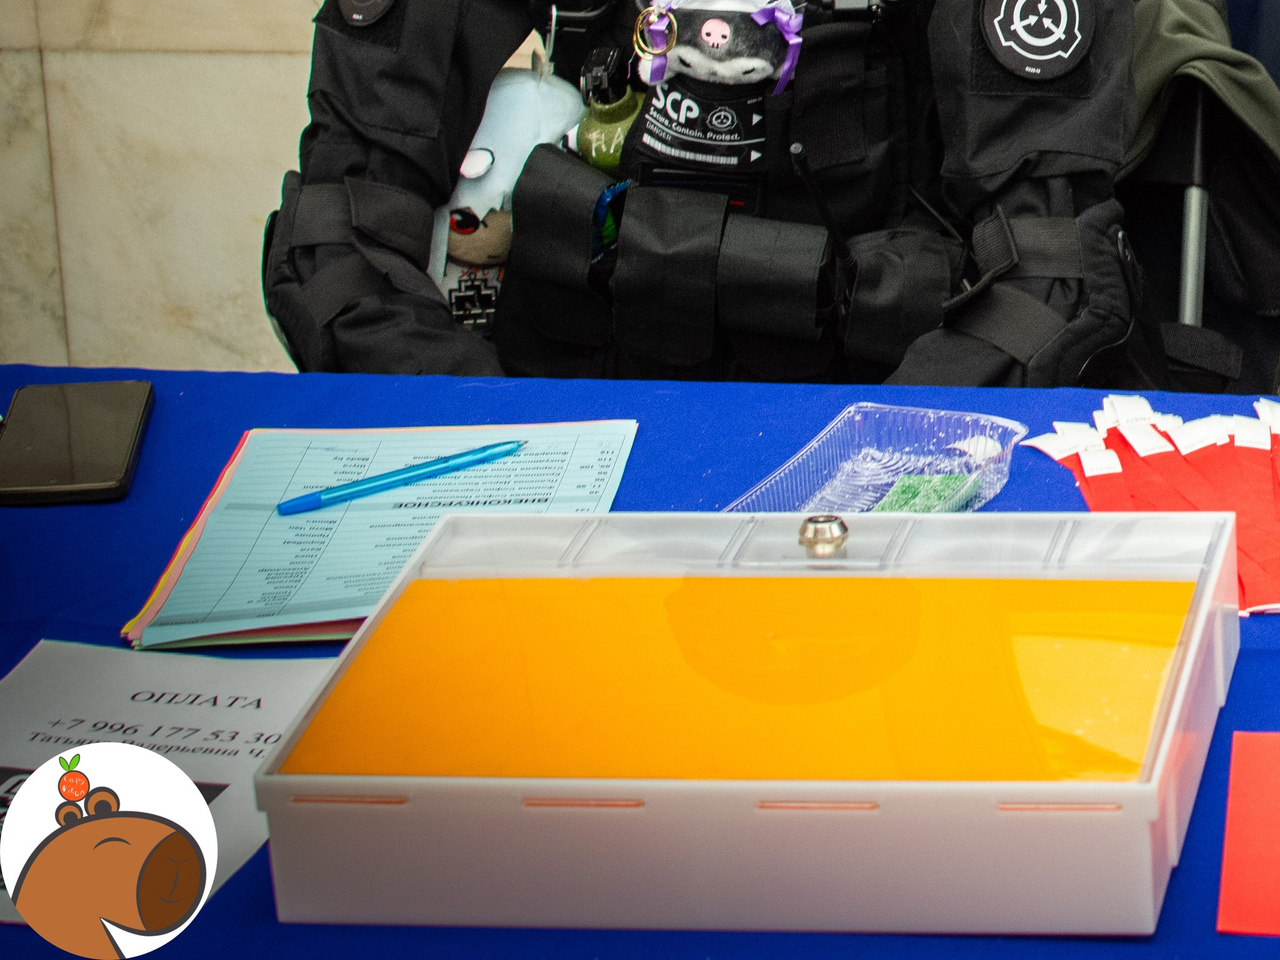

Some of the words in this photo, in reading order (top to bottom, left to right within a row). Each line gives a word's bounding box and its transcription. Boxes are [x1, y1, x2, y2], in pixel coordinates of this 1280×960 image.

[651, 83, 701, 124] SCP
[392, 497, 549, 509] ВНЕКОНКУРСНОЕ
[130, 690, 262, 709] ОПЛАТА
[49, 718, 86, 730] +7
[90, 720, 143, 736] 996
[149, 725, 201, 740] 177
[203, 729, 240, 743] 53
[245, 732, 282, 746] 30
